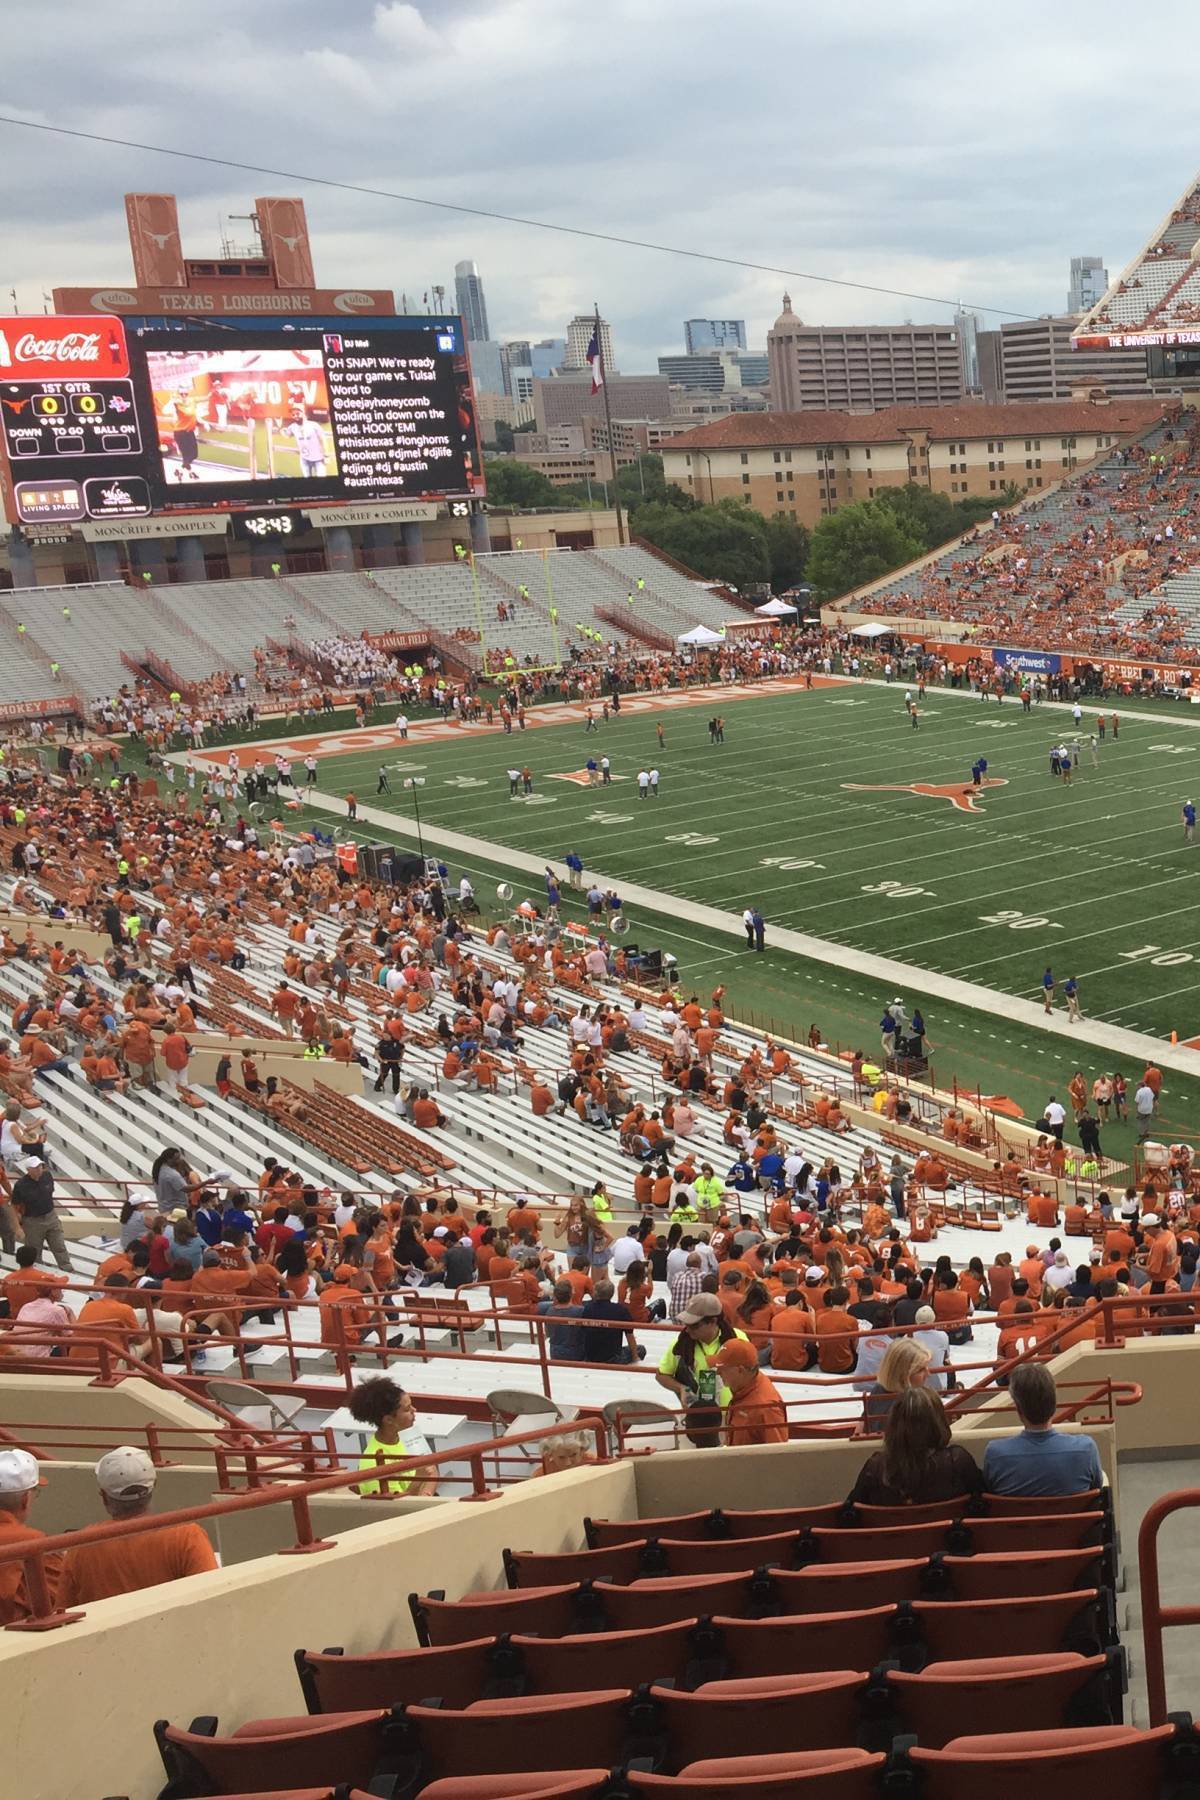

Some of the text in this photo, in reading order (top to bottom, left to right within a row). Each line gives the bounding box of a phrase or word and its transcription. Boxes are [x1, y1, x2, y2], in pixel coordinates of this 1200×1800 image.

[160, 294, 312, 311] TEXAS LONGHORNS
[1108, 332, 1200, 347] THE UNIVERSITY OF TEXAS
[327, 357, 435, 369] OH SNAP! We're ready
[329, 370, 436, 383] for our game vs. Tulsa!
[42, 382, 91, 393] 1ST QTR
[330, 385, 371, 395] Word to
[42, 397, 58, 414] 0
[80, 396, 96, 413] 0
[333, 396, 430, 410] @deejayhoneycomb
[335, 409, 445, 423] holding in down on the
[9, 428, 42, 437] DOWN
[52, 426, 84, 436] TO GO
[94, 425, 135, 435] BALL ON
[336, 425, 360, 435] field.
[363, 424, 393, 434] HOOK
[339, 435, 449, 447] #thisistexas #longhorns
[340, 447, 452, 461] #hookem #djmel #djlife
[342, 461, 428, 476] #djing #dj #austin
[344, 476, 404, 487] #austintexas
[23, 503, 80, 513] LIVING SPACES
[452, 503, 469, 517] 25
[320, 508, 429, 523] MONCRIEF COMPLEX
[94, 520, 217, 537] MONCRIEF COMPLEX
[245, 516, 293, 535] 42:43
[408, 634, 428, 645] FIELD
[0, 702, 42, 715] MOKEY
[664, 832, 720, 846] 50
[759, 856, 814, 871] 40
[861, 881, 922, 898] 30
[978, 910, 1049, 930] 20
[1118, 944, 1193, 967] 10
[710, 1230, 726, 1247] 12
